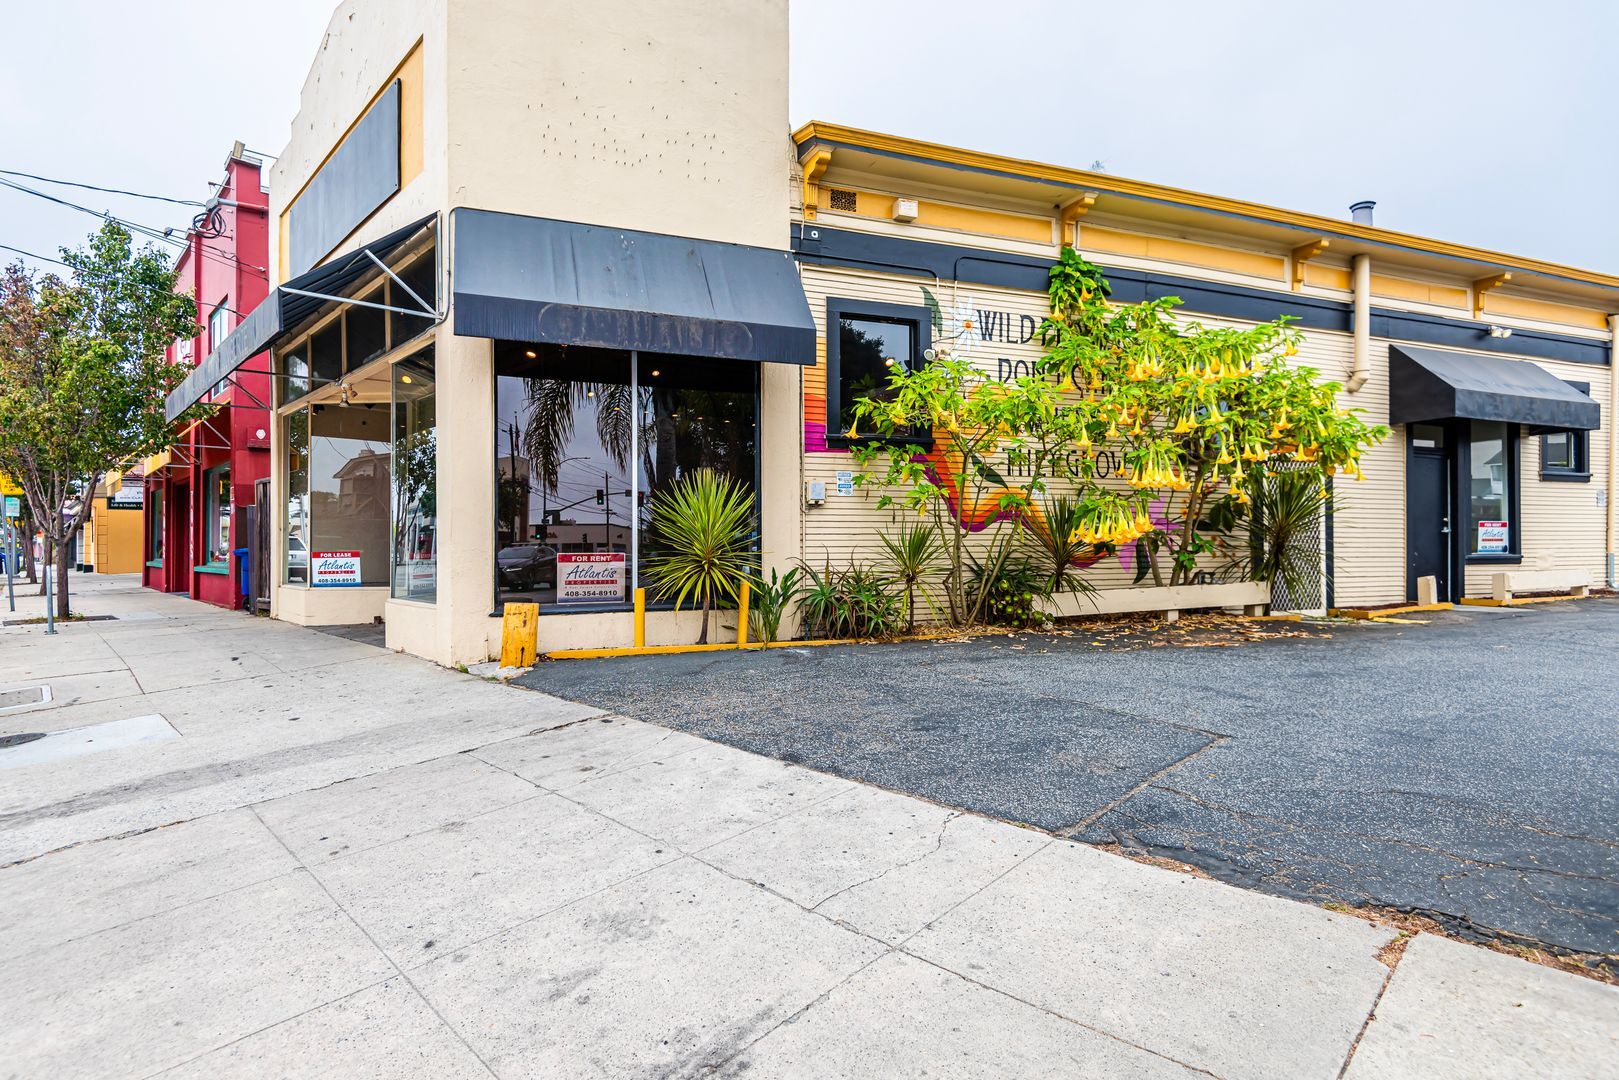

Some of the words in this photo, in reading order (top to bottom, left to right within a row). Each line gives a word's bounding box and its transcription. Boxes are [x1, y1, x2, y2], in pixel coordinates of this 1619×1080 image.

[976, 309, 1036, 344] WILD
[1001, 447, 1063, 478] THY
[1066, 449, 1129, 478] GOW
[318, 559, 355, 570] Atlantis
[566, 564, 617, 579] Atlantis
